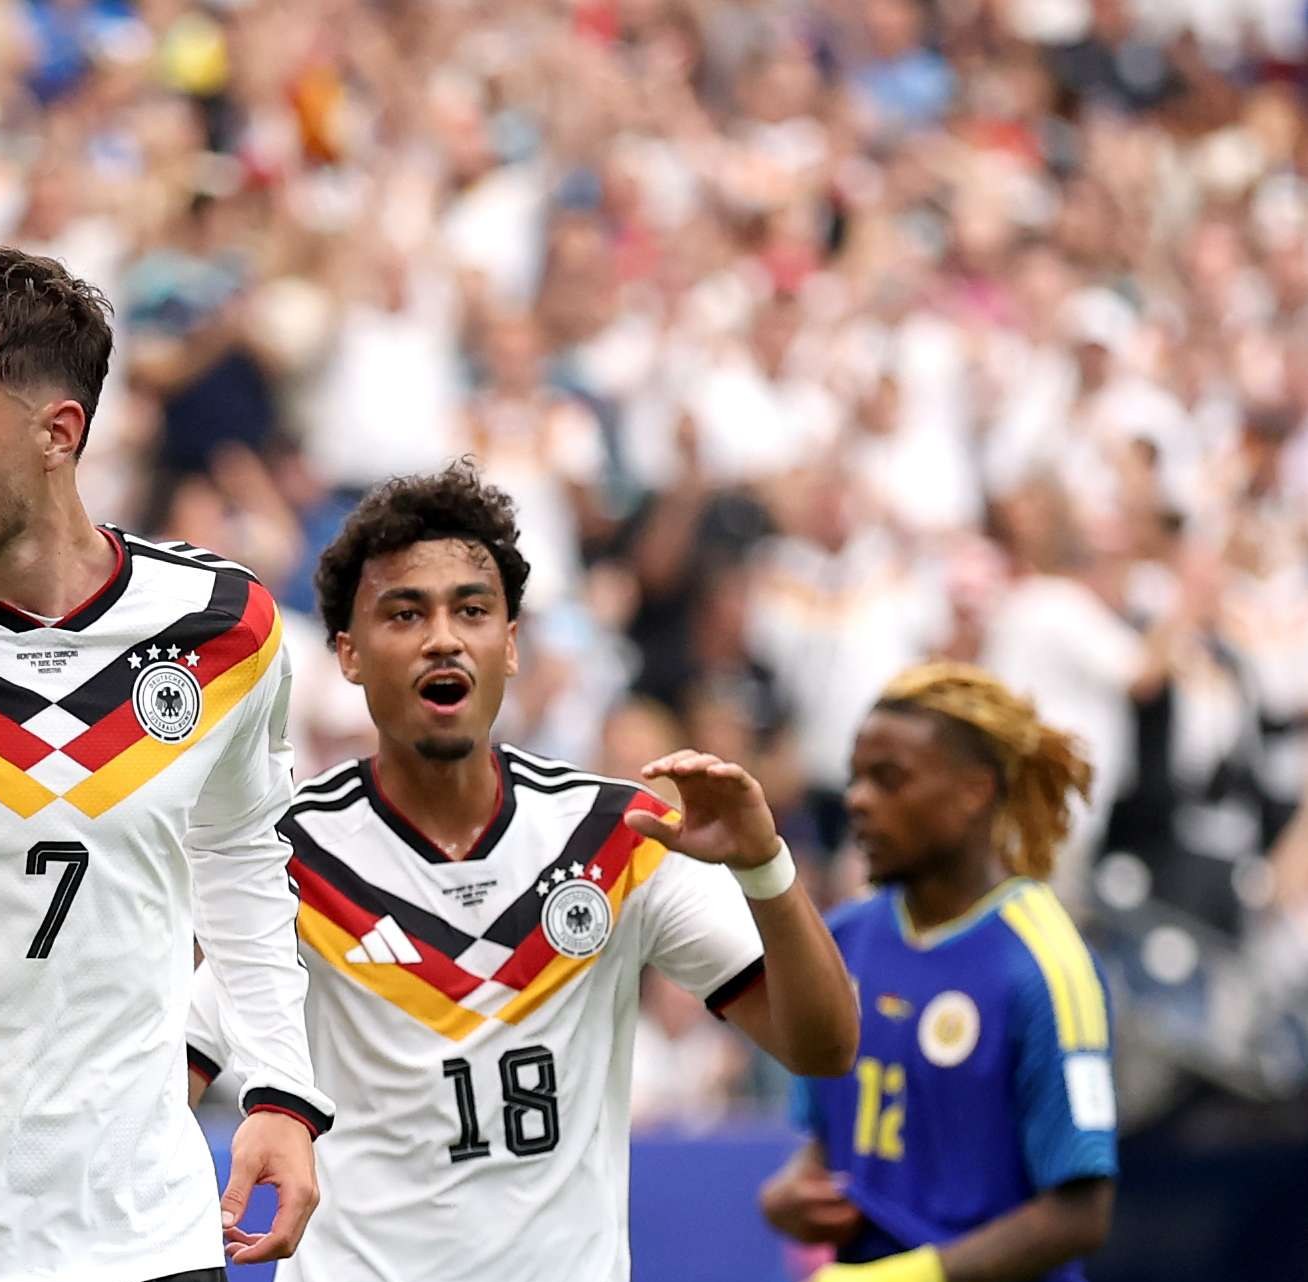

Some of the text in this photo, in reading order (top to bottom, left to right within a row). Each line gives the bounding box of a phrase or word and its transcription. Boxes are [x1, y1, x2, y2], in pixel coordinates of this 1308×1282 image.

[24, 840, 90, 959] 7
[442, 1044, 561, 1163] 18
[854, 1057, 906, 1162] 12
